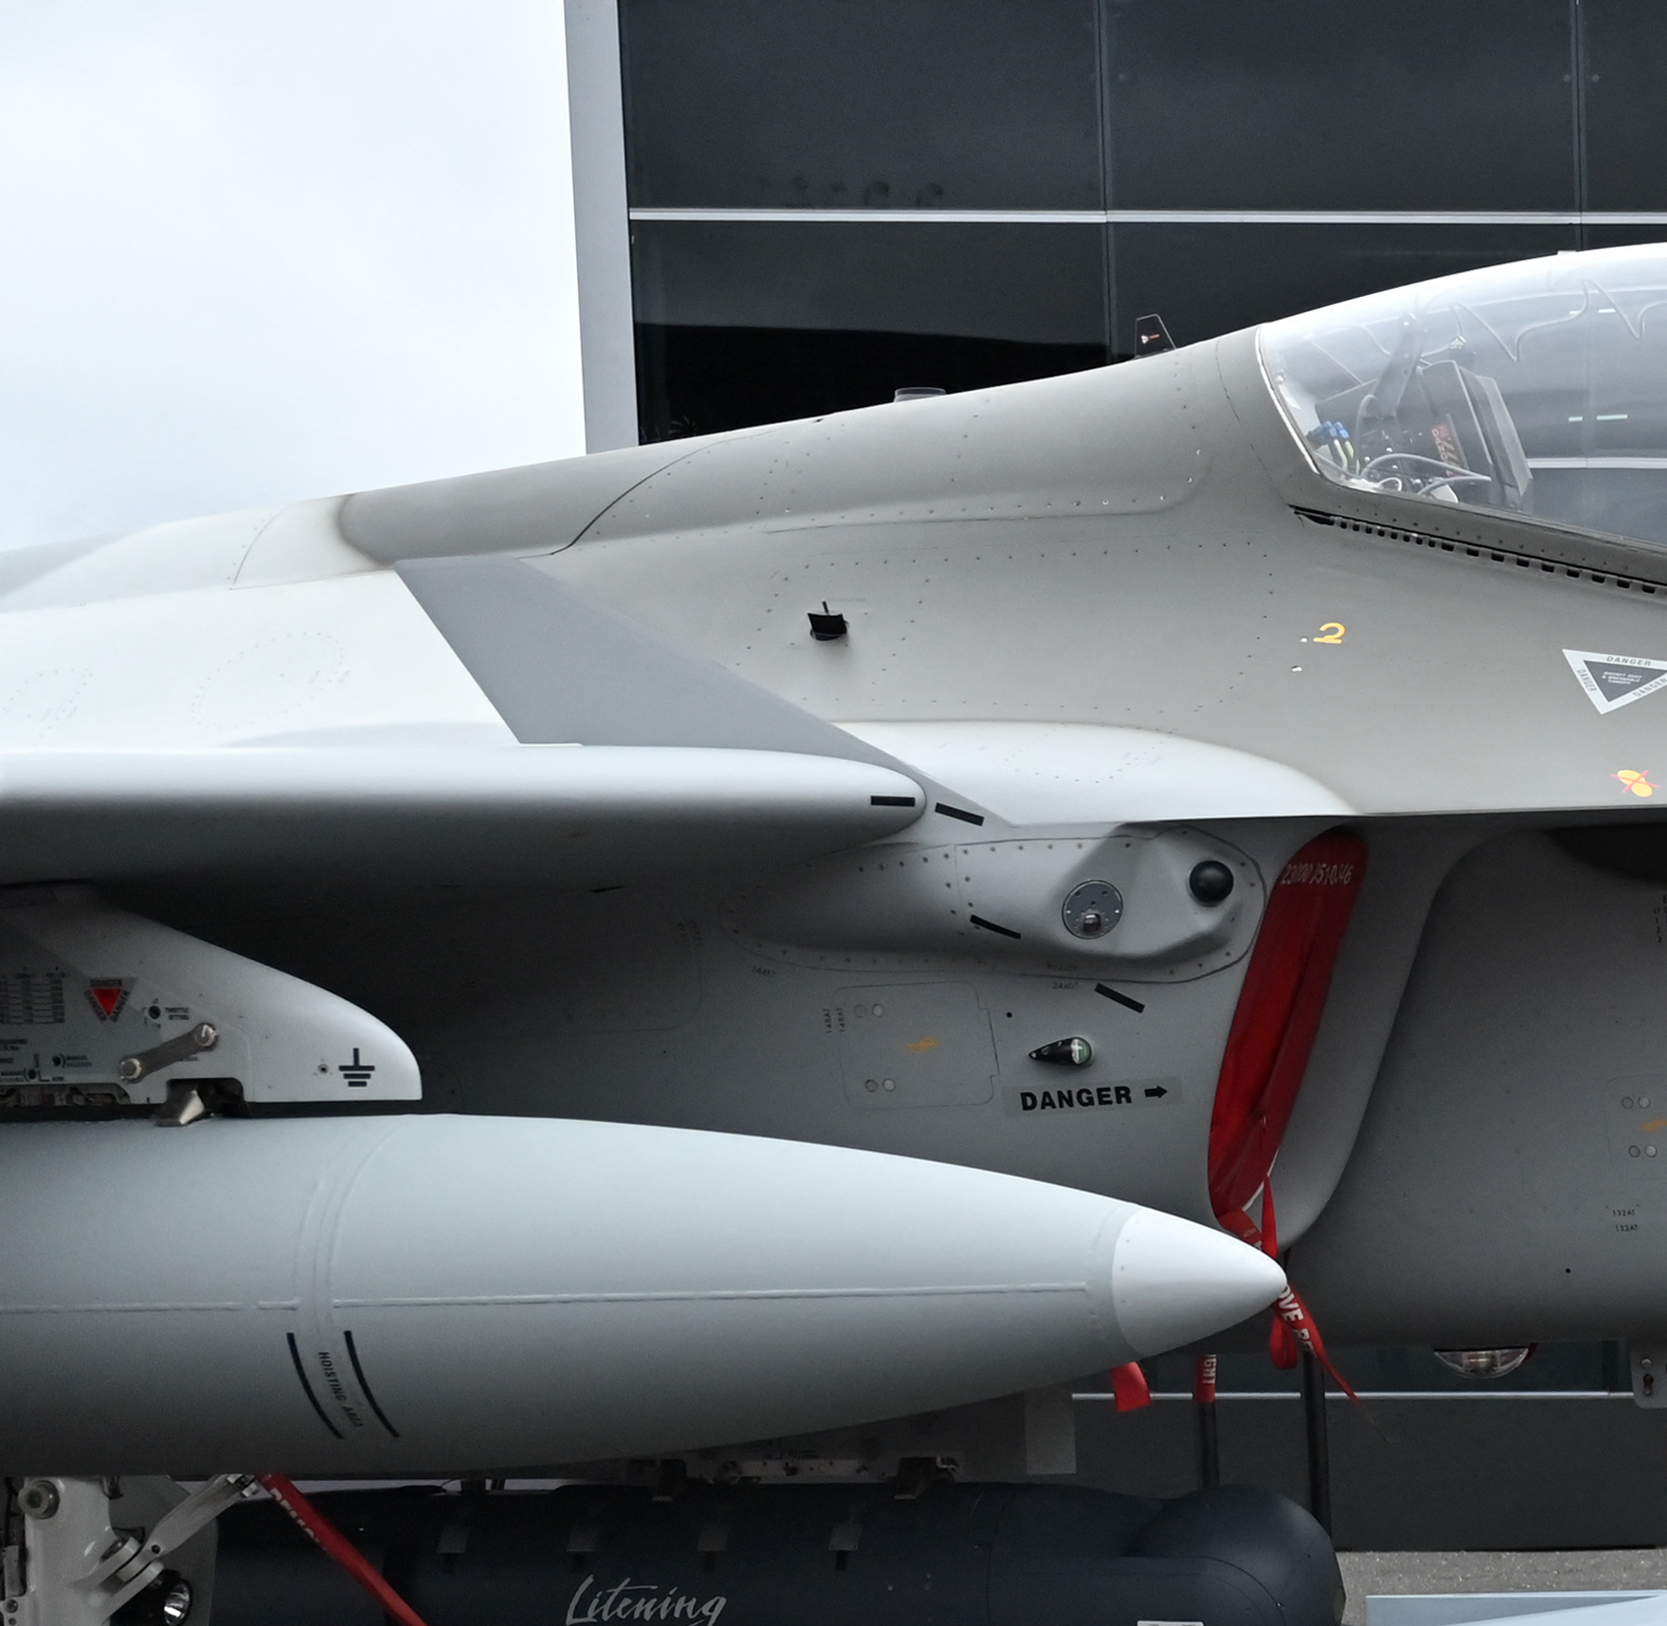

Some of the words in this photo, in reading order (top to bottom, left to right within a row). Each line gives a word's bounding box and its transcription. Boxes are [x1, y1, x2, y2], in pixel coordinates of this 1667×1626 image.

[1313, 622, 1345, 644] 2
[1606, 656, 1651, 667] DANGER
[1020, 1085, 1133, 1111] DANGER
[318, 1352, 347, 1402] HOISTING
